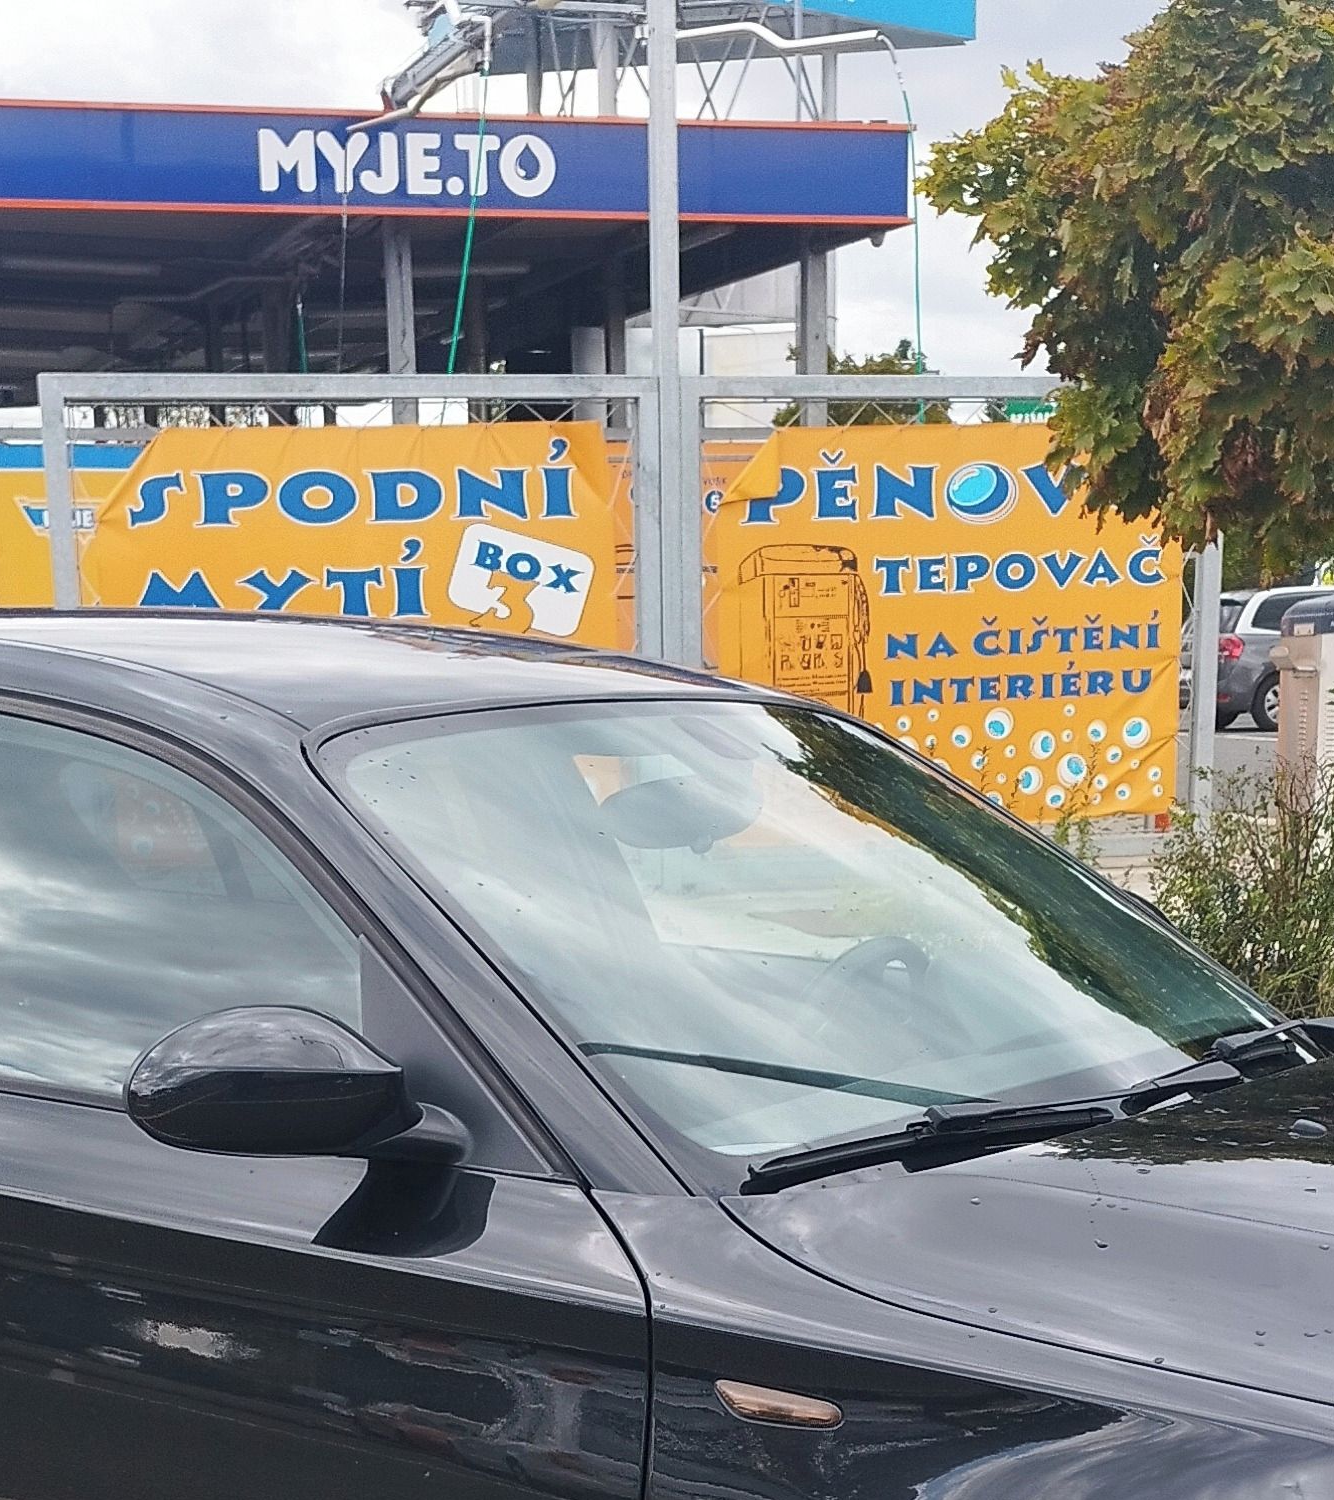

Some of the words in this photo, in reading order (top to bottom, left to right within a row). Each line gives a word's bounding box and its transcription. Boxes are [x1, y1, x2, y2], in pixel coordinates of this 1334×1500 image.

[257, 127, 556, 198] MYJE.TO
[127, 437, 579, 529] SPODNÍ
[741, 449, 1069, 524] PĚNOV
[138, 537, 431, 619] MYTÍ
[469, 540, 585, 593] BOX
[874, 534, 1166, 596] TEPOVAČ
[471, 570, 534, 633] 3
[883, 631, 959, 660] NA
[972, 609, 1161, 656] ČIŠTĚNÍ
[889, 660, 1153, 707] INTERIÉRU
